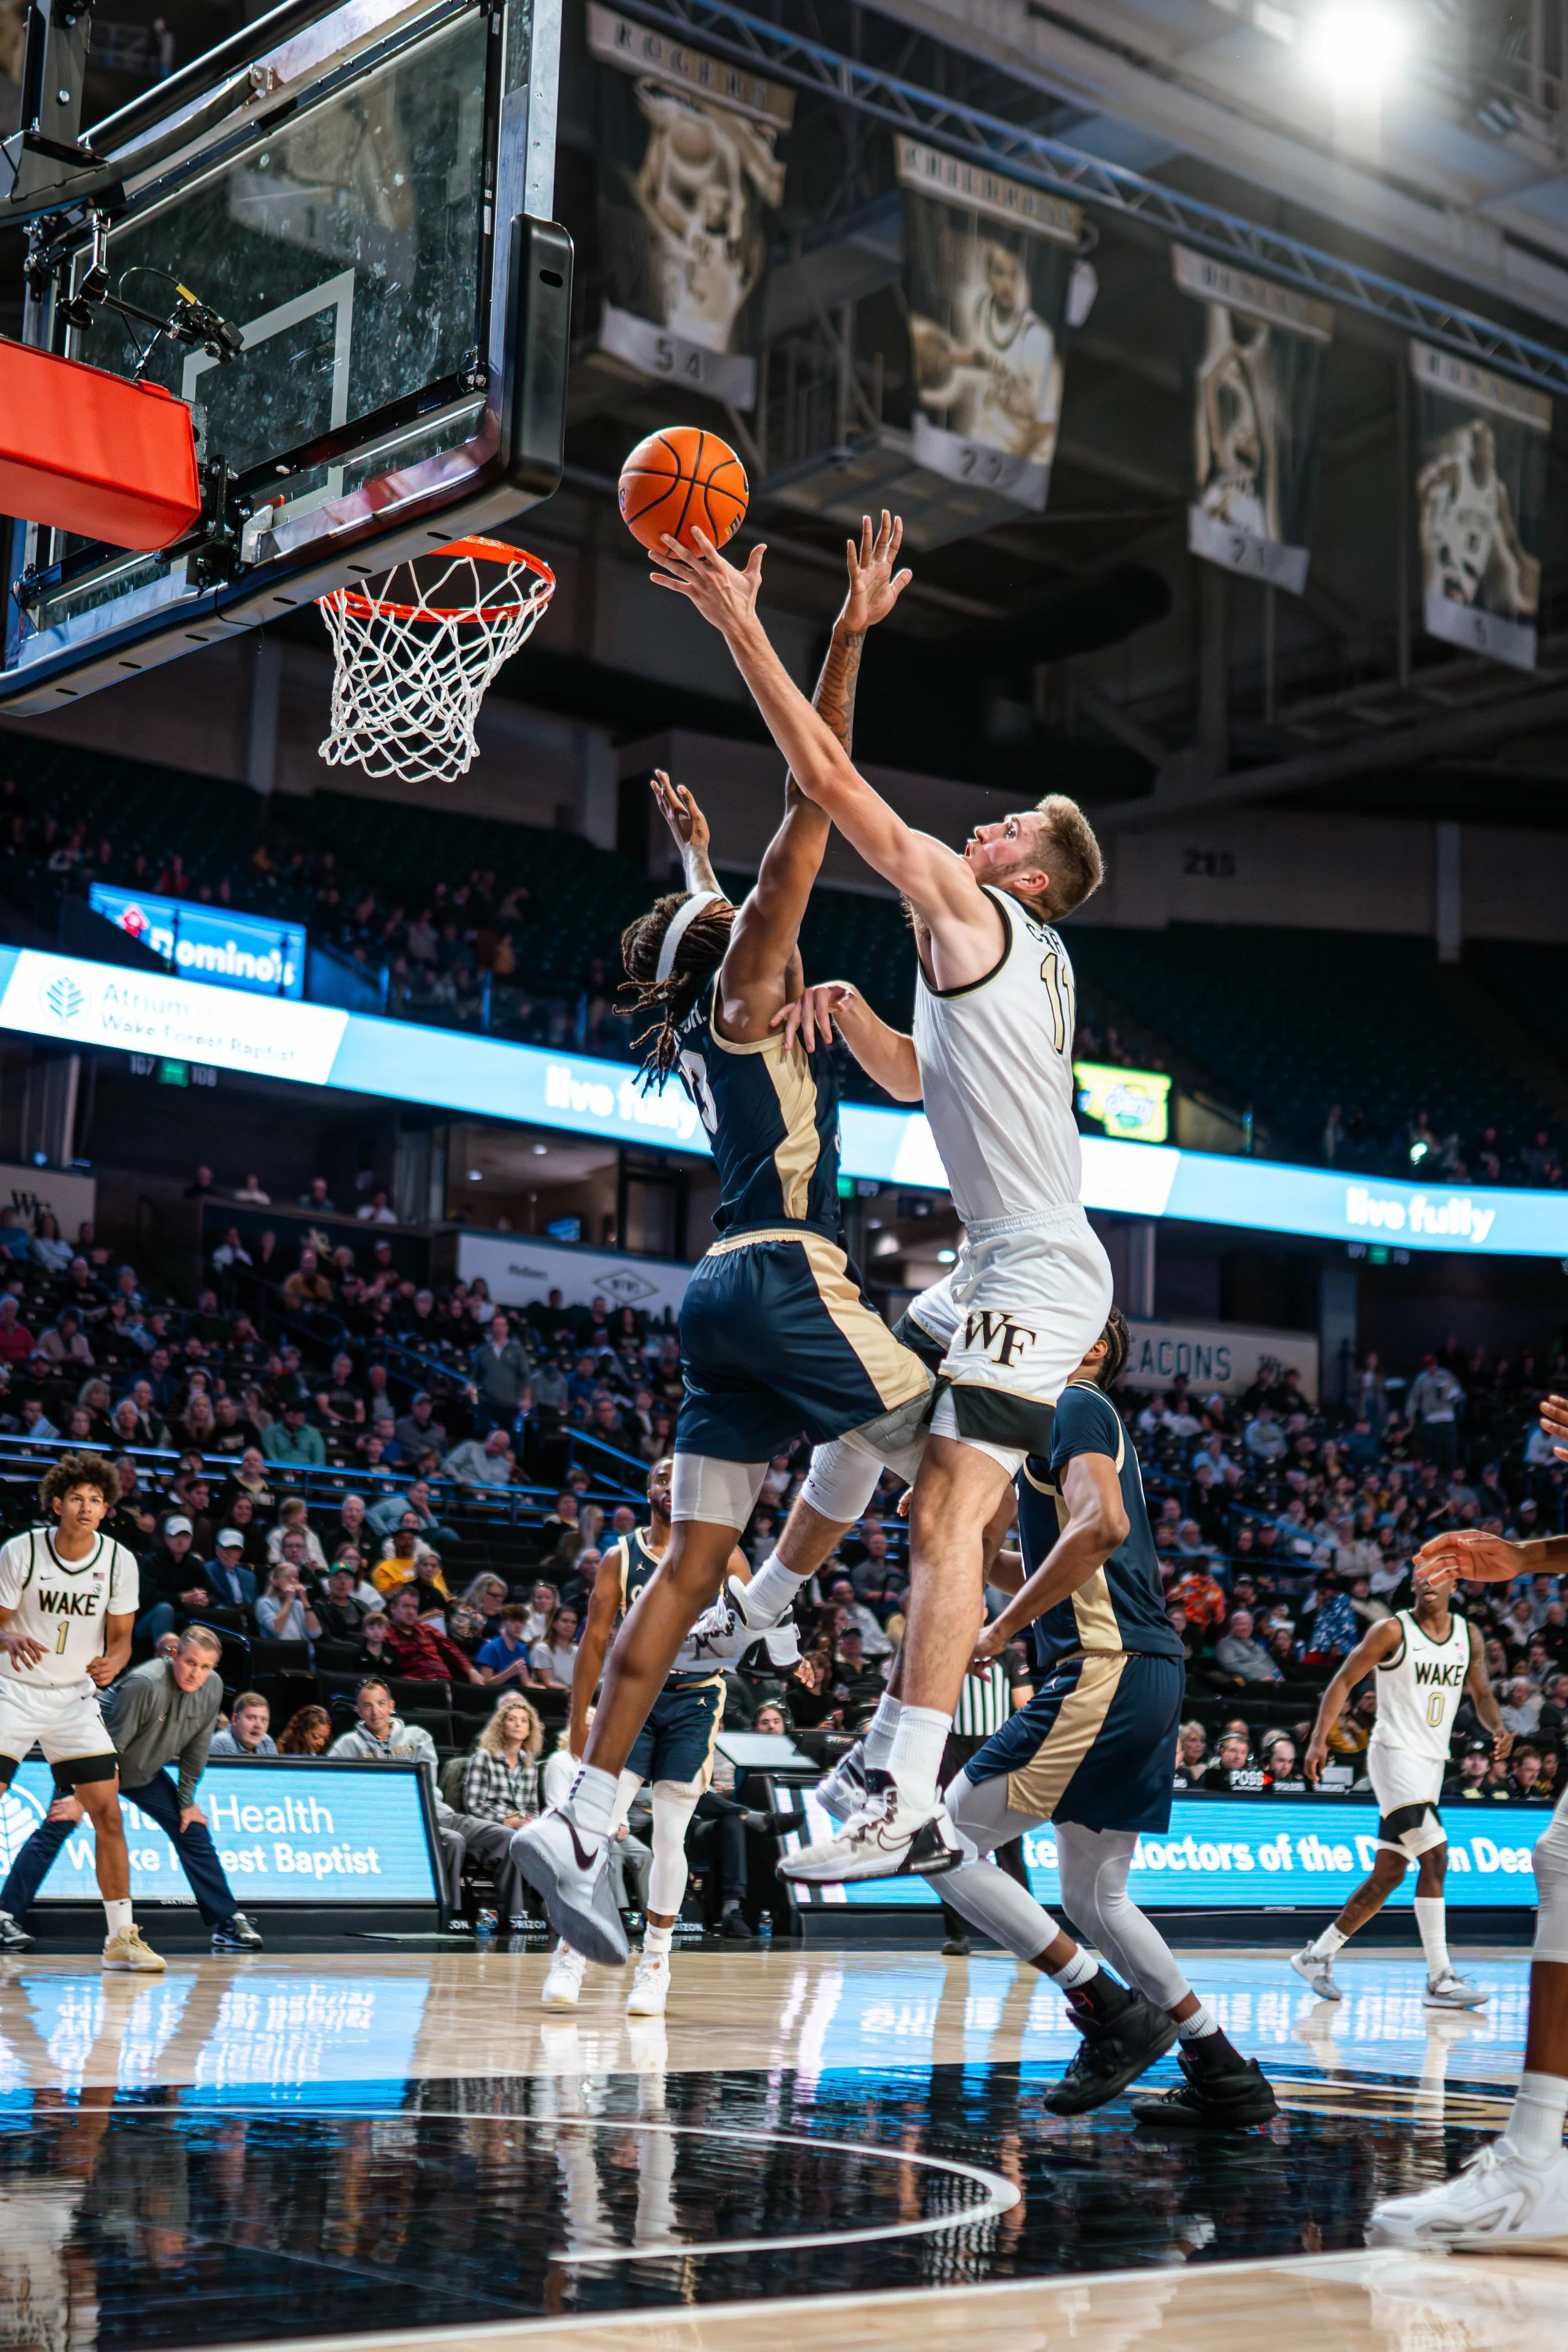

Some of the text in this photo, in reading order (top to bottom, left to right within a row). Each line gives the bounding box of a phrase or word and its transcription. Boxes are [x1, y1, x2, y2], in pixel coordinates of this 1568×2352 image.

[655, 336, 702, 379] 54
[546, 1064, 701, 1140] live fully
[1346, 1186, 1496, 1244] live fully
[965, 1310, 1037, 1369] WF
[38, 1589, 100, 1617] WAKE
[56, 1621, 70, 1655] 1
[1415, 1661, 1465, 1687] WAKE
[1426, 1692, 1446, 1728] 0
[1230, 1770, 1264, 1787] POSS
[208, 1793, 335, 1835] Health
[65, 1838, 161, 1872] Wke
[272, 1841, 382, 1880] Baptist
[1258, 1833, 1293, 1872] of
[1296, 1834, 1355, 1872] the
[1470, 1836, 1534, 1873] Dea
